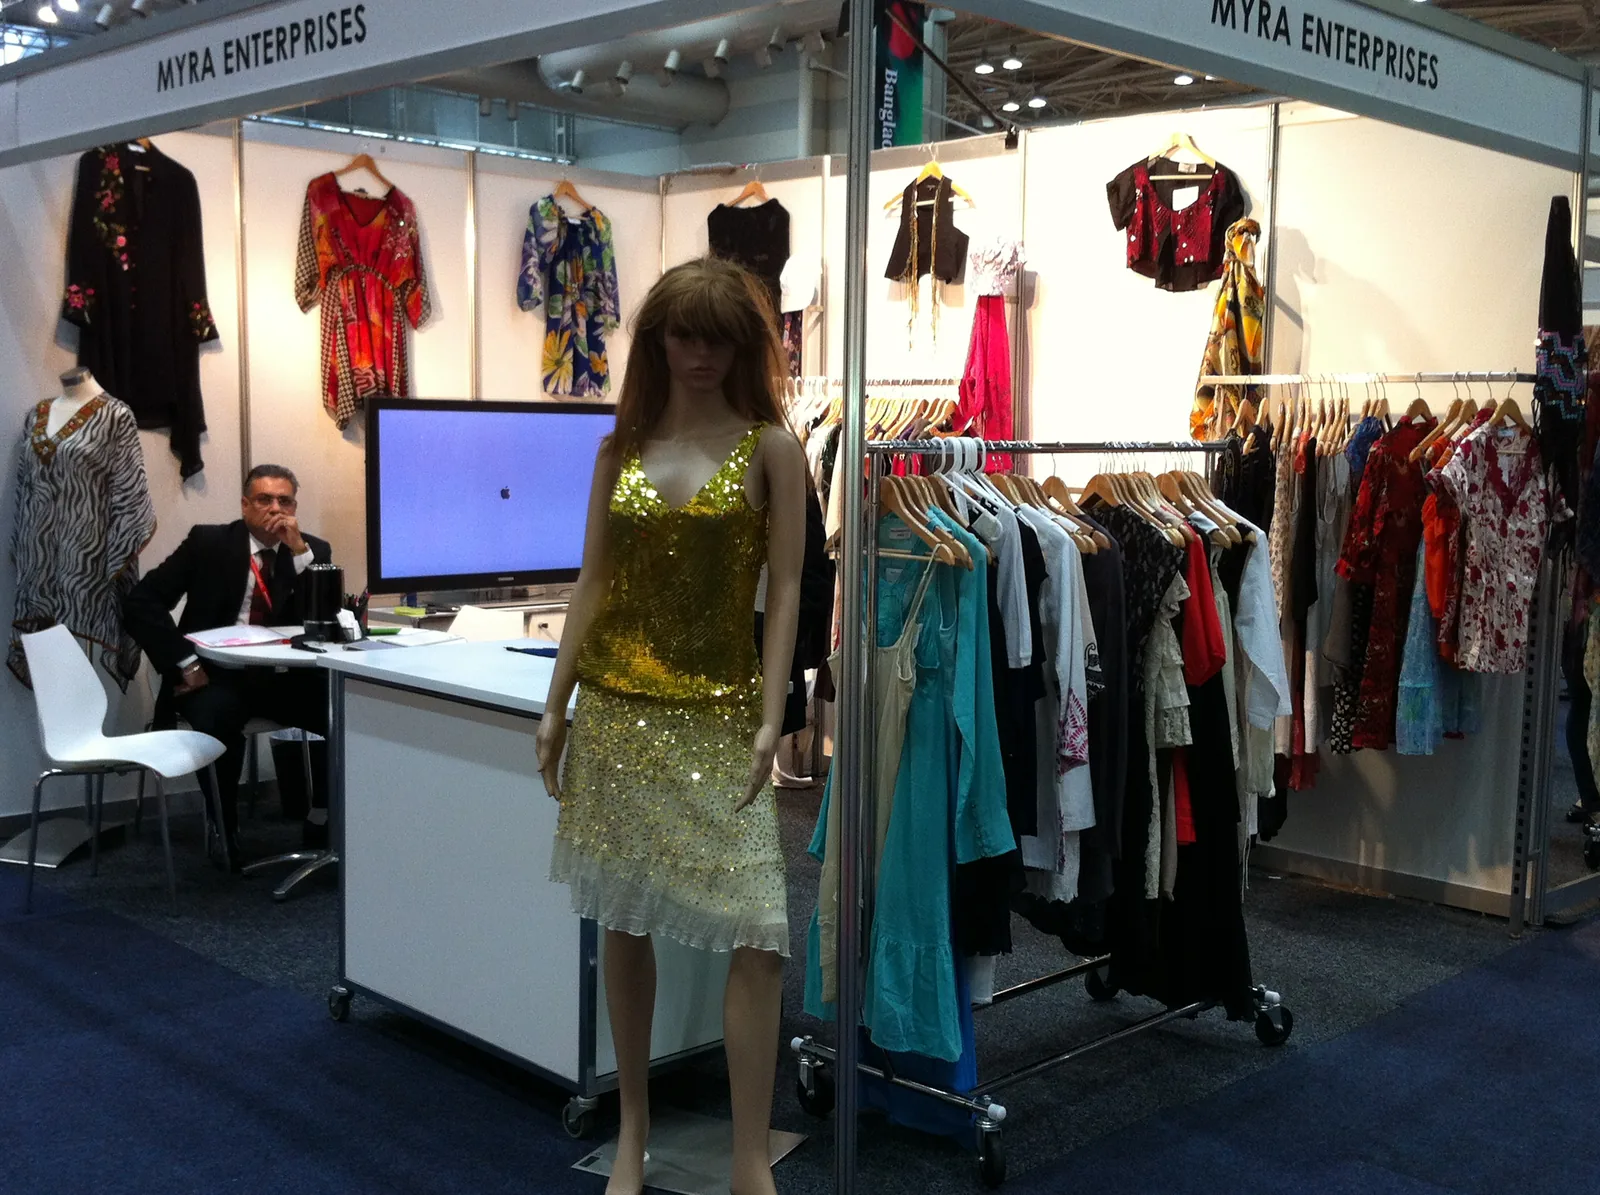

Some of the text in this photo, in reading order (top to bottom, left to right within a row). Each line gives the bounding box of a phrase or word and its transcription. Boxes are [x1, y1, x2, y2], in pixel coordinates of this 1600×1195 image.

[157, 4, 367, 92] MYRA ENTERPRISES
[1211, 0, 1438, 90] MYRA ENTERPRISES
